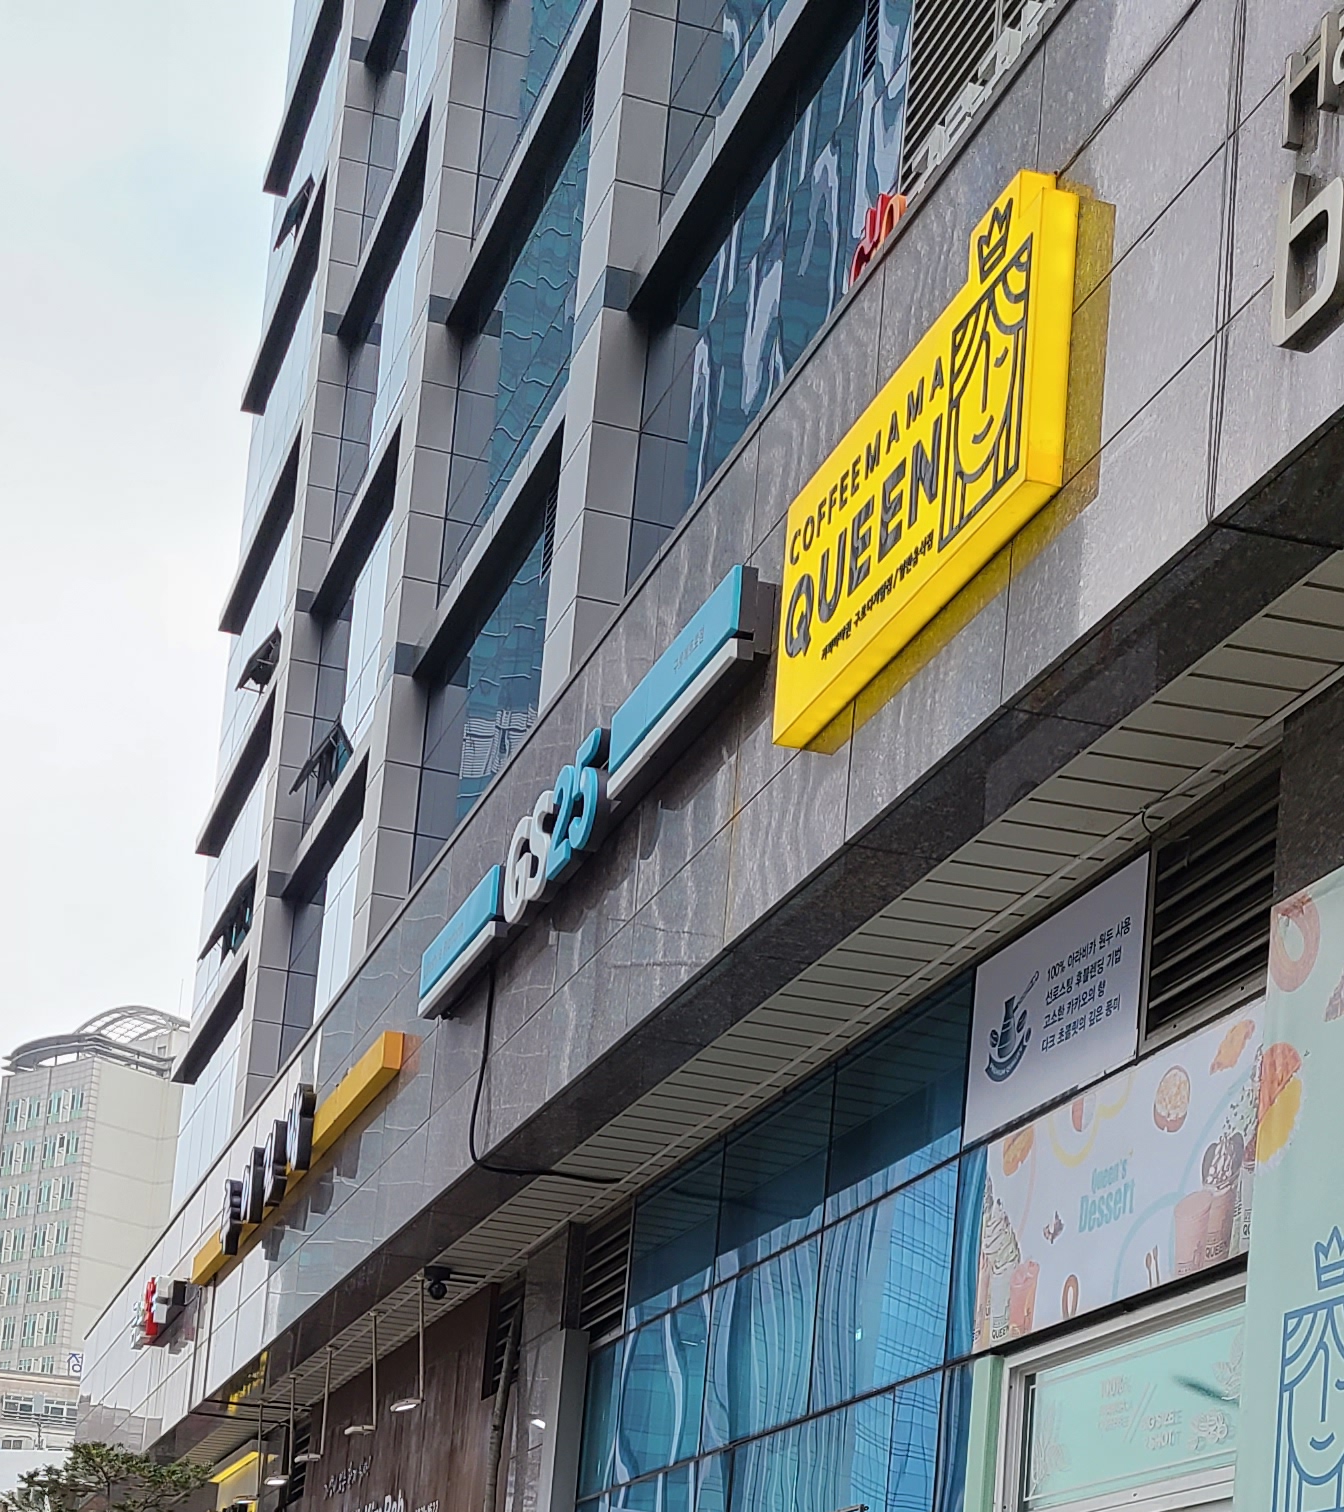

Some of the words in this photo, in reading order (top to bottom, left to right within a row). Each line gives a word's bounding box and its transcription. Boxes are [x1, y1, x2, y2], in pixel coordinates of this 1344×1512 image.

[785, 412, 942, 658] QUEEN
[503, 727, 602, 923] GS25
[1047, 960, 1066, 982] 100%
[1067, 939, 1096, 968] 아라비카
[1115, 916, 1131, 938] 사용
[1106, 945, 1122, 968] 기법
[1043, 1004, 1064, 1029] 고소한
[1066, 985, 1095, 1015] 카카오의
[1078, 1178, 1135, 1233] Dessert
